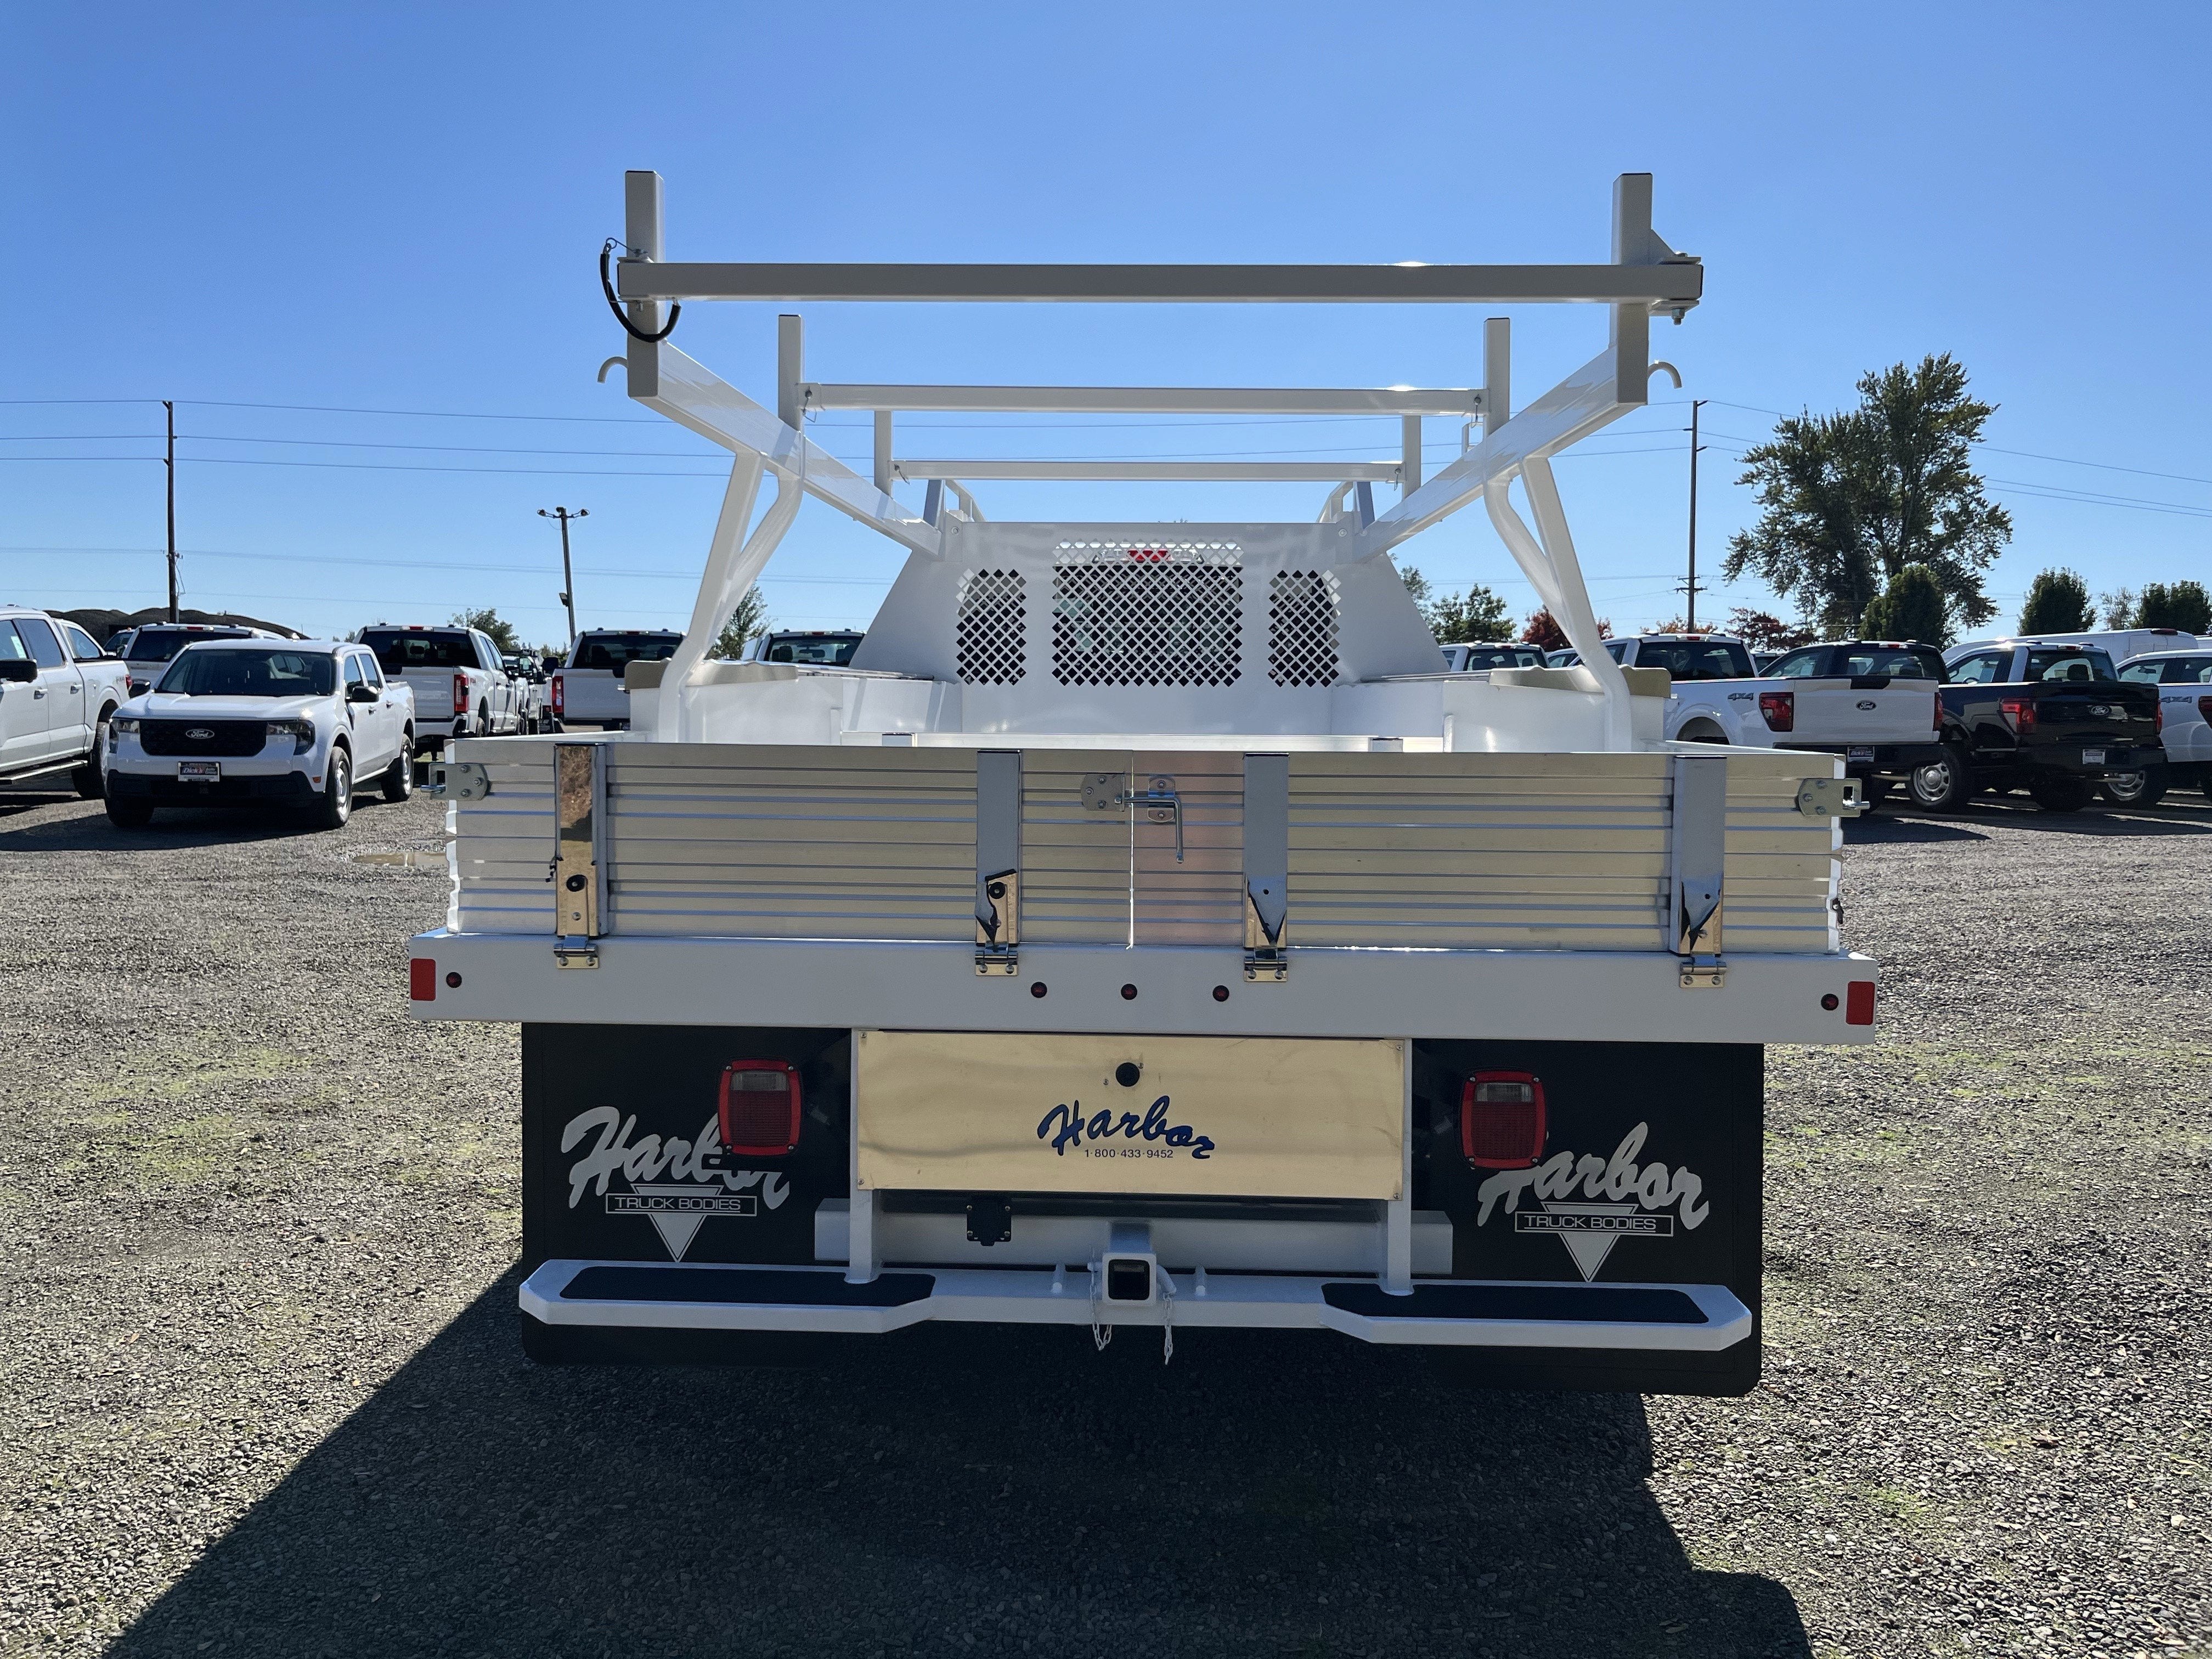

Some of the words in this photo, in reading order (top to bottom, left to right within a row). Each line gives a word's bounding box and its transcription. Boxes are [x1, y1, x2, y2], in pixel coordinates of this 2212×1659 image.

[1037, 1096, 1215, 1159] Harbor
[614, 1197, 675, 1209] TRUCK
[678, 1198, 741, 1210] BODIES
[1524, 1215, 1587, 1228] TRUCK
[1590, 1217, 1657, 1230] BODIES
